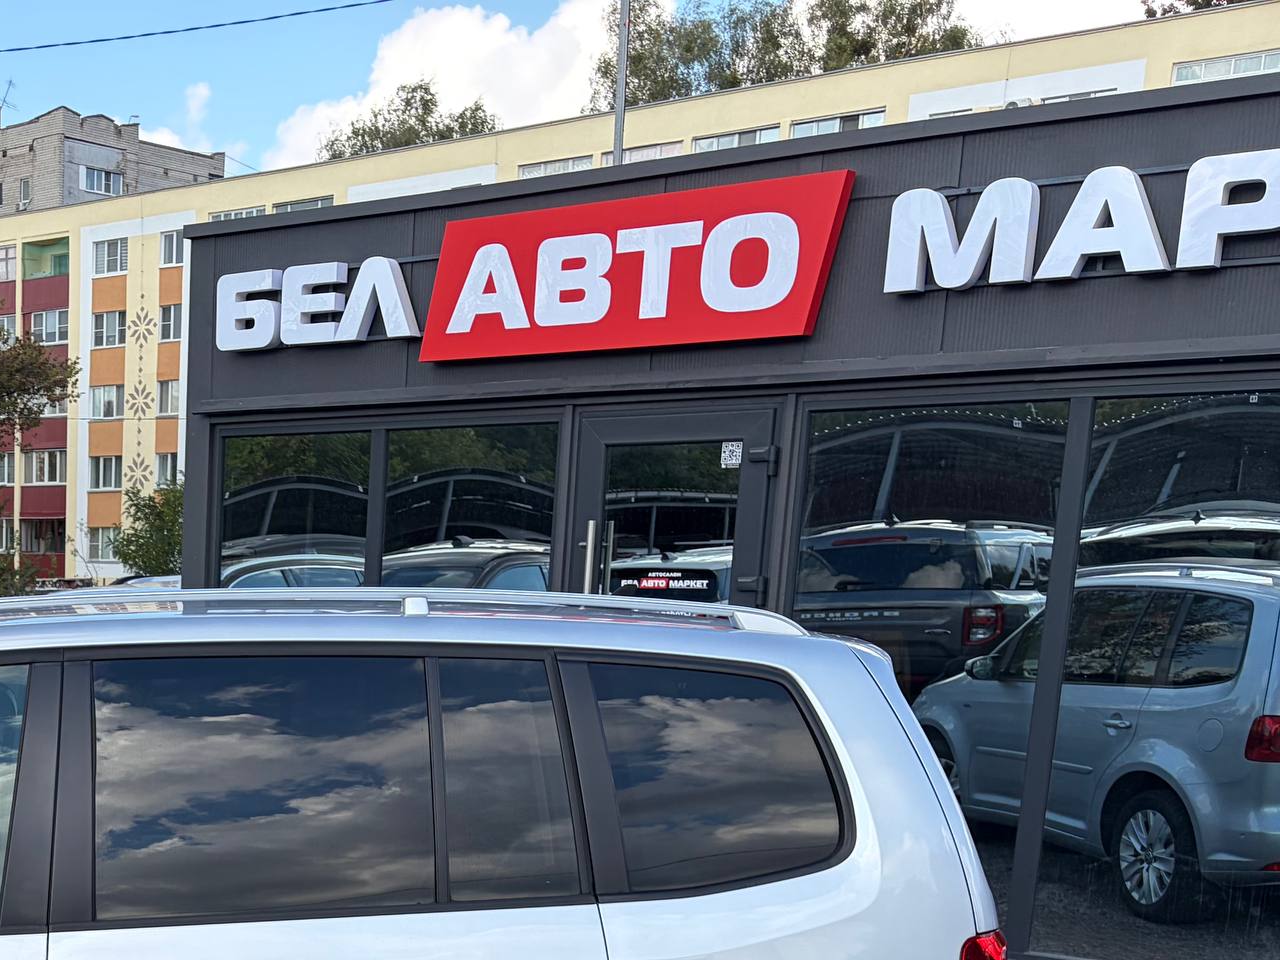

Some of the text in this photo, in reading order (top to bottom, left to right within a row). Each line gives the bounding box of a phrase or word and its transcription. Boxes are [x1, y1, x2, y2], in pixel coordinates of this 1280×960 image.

[216, 256, 421, 351] БЕЛ
[445, 211, 800, 334] АВТО
[669, 580, 709, 589] МАРКЕТ
